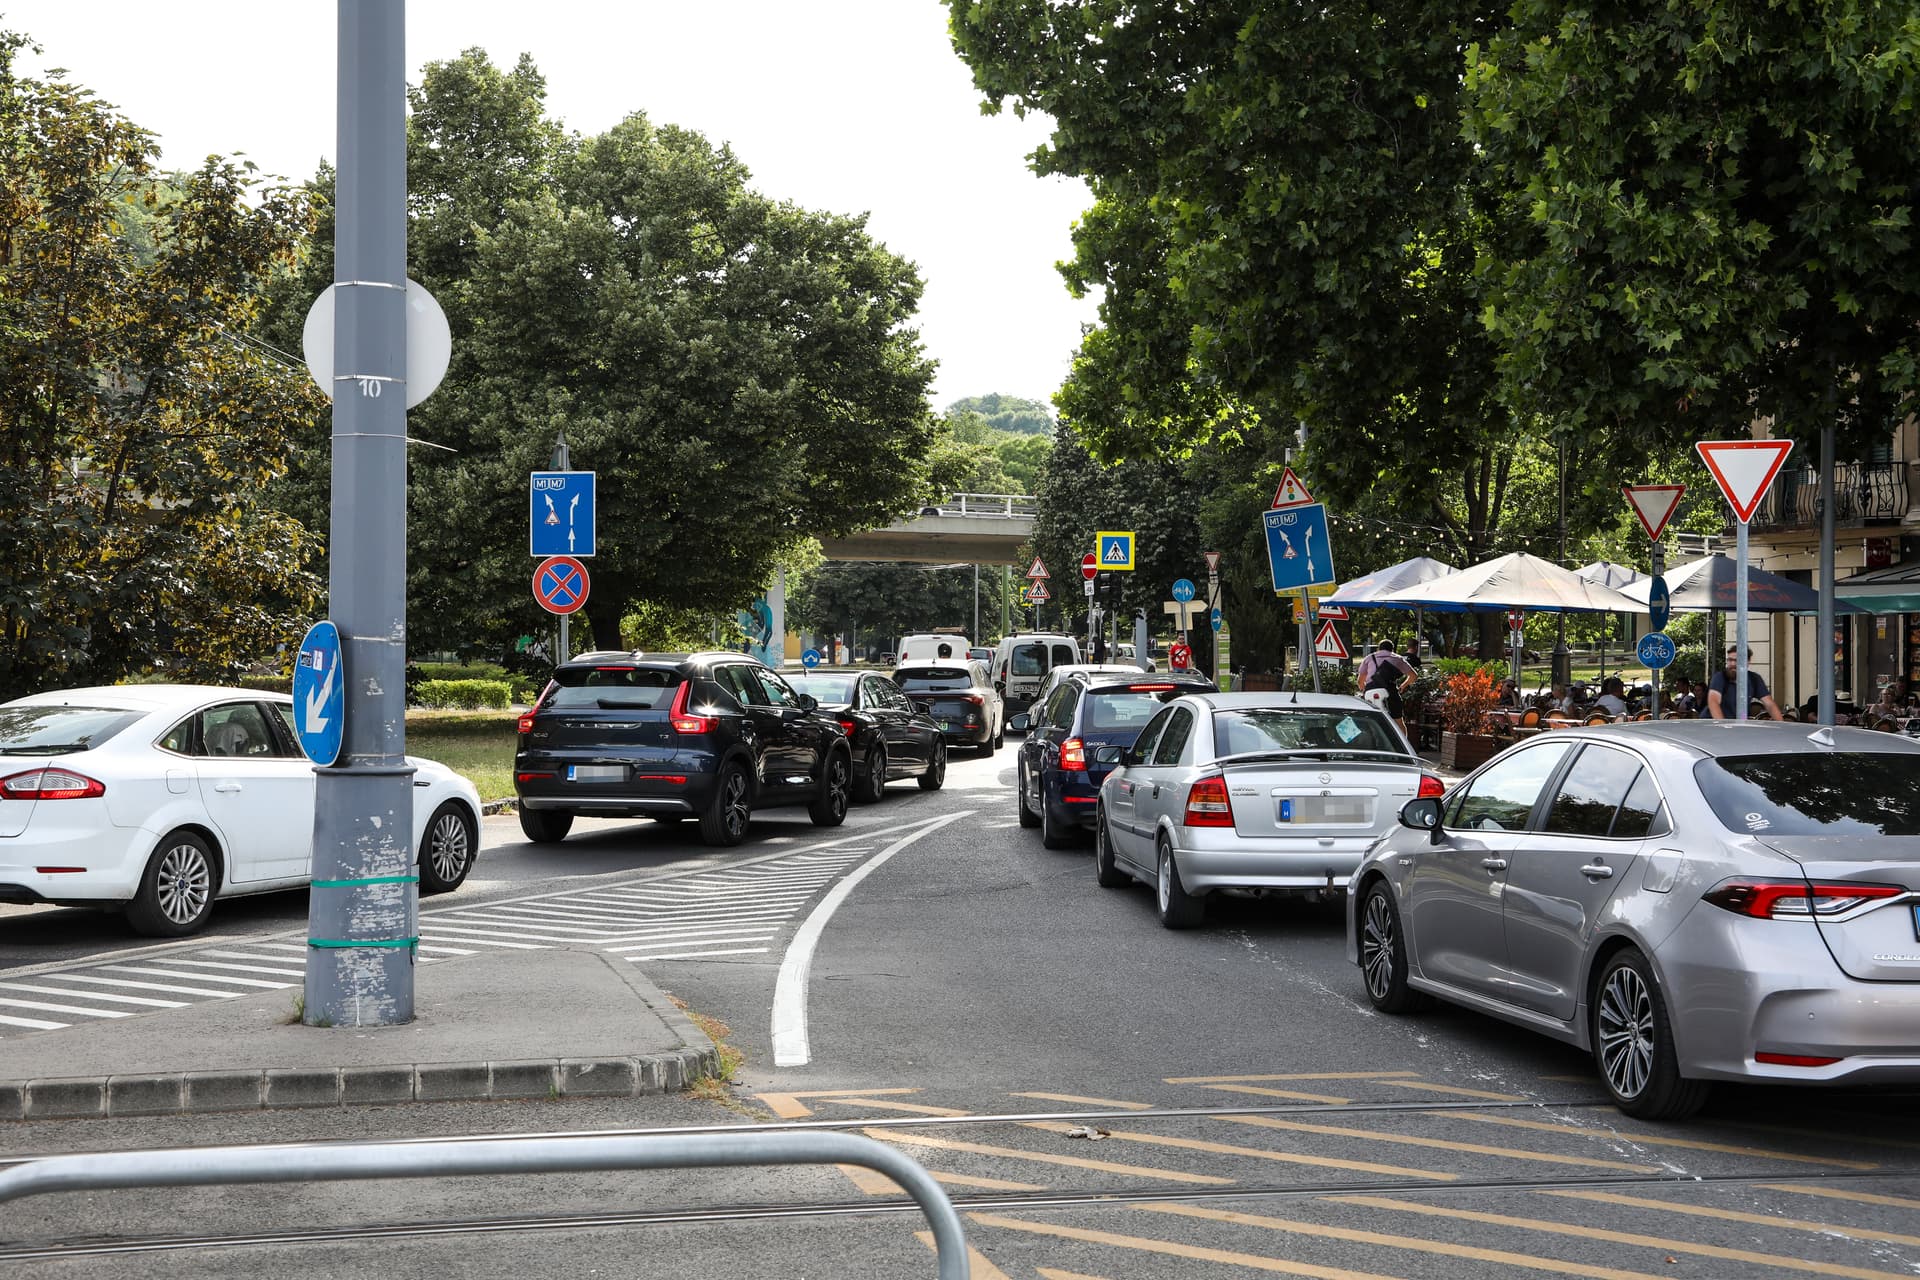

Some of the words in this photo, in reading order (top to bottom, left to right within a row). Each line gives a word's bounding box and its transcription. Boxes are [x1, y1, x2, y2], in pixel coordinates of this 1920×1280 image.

[358, 379, 382, 398] 10
[536, 479, 547, 488] M1
[551, 479, 563, 488] M7
[1269, 517, 1280, 526] M1
[1283, 514, 1295, 524] M7
[1318, 660, 1329, 669] 30
